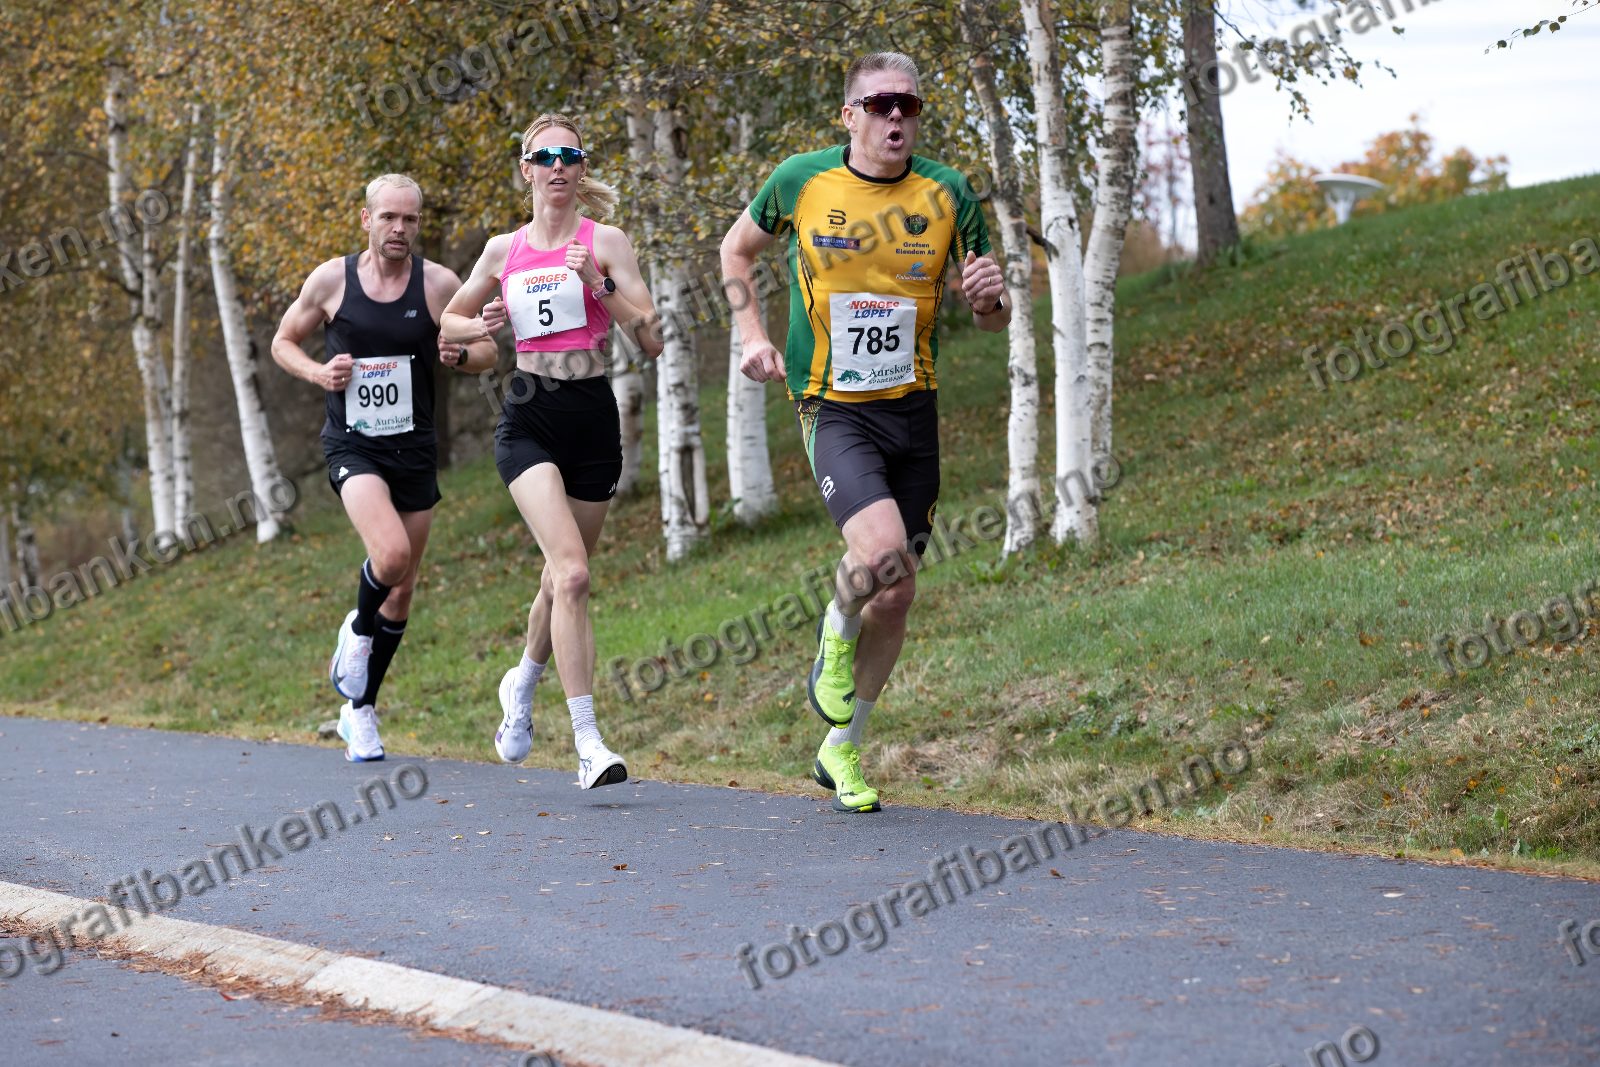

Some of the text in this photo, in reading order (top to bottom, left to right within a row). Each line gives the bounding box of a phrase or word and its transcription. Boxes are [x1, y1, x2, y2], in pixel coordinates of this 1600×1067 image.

[523, 273, 568, 286] NORGES
[526, 282, 561, 294] LØPET
[850, 300, 900, 310] NORGES
[538, 298, 554, 327] 5
[854, 308, 895, 319] LØPET
[847, 324, 900, 356] 785
[359, 361, 399, 372] NORGES
[868, 362, 912, 378] Aurskog
[362, 369, 392, 379] LØPET
[357, 382, 399, 408] 990
[374, 415, 412, 427] Aurskog
